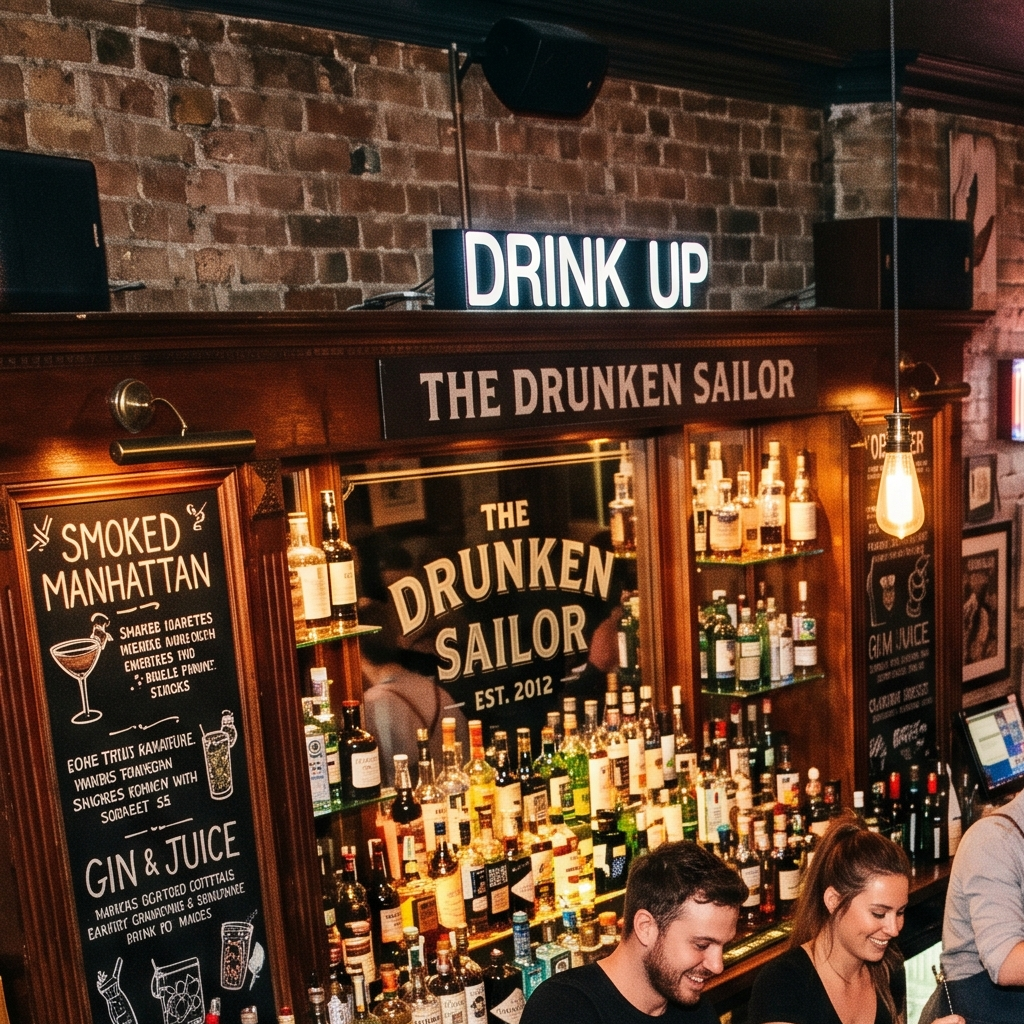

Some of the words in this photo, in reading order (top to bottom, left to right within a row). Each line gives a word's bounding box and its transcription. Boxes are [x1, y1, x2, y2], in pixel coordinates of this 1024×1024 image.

[464, 230, 630, 308] DRINK
[648, 240, 709, 309] UP
[419, 370, 501, 422] THE
[512, 363, 683, 416] DRUNKEN
[693, 359, 796, 405] SAILOR
[61, 512, 181, 563] SMOKED
[480, 500, 530, 531] THE
[41, 551, 211, 612] MANHATTAN
[387, 537, 615, 637] DRUNKEN
[435, 604, 589, 684] SAILOR
[474, 685, 509, 712] EST.
[514, 675, 553, 701] 2012
[85, 849, 138, 898] GIN
[144, 847, 160, 876] &
[165, 820, 240, 876] JUICE
